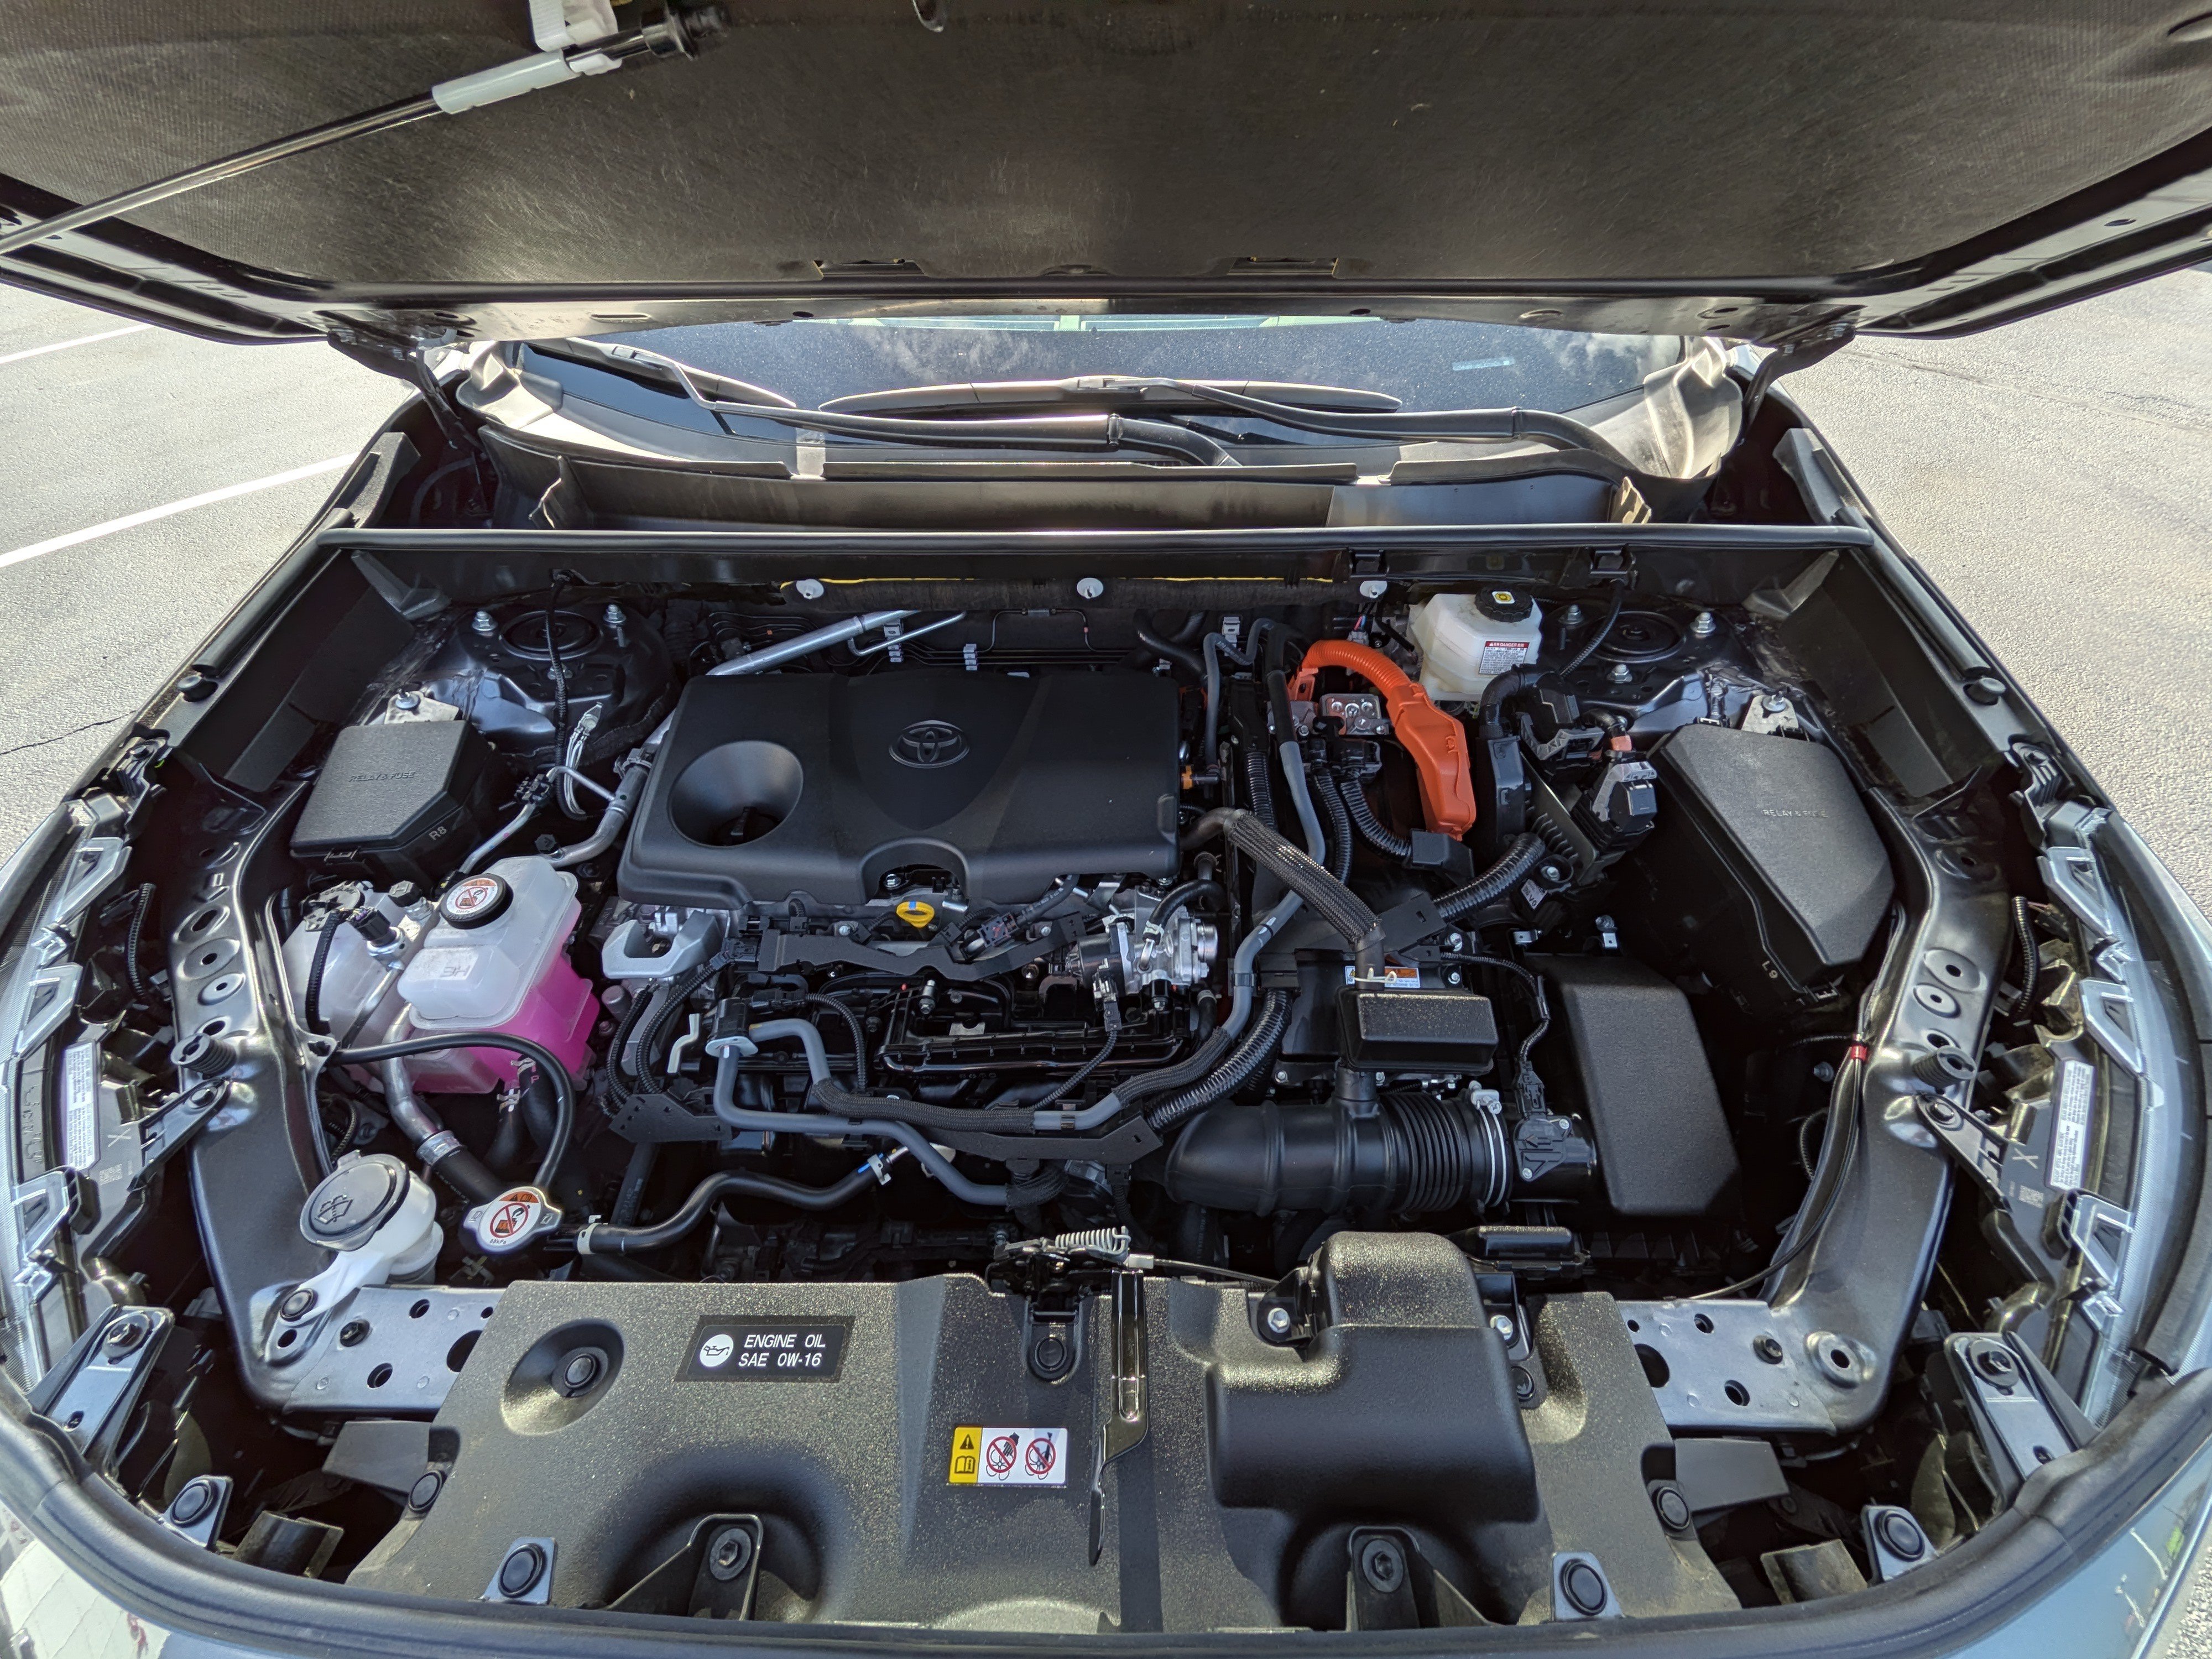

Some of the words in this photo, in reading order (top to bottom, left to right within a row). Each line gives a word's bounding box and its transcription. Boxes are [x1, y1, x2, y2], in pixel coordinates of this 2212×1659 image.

[390, 771, 415, 780] FUSE
[429, 826, 447, 841] R8
[744, 1334, 795, 1348] ENGINE
[804, 1334, 826, 1348] OIL
[738, 1353, 768, 1366] SAE
[777, 1353, 822, 1366] 0W-16
